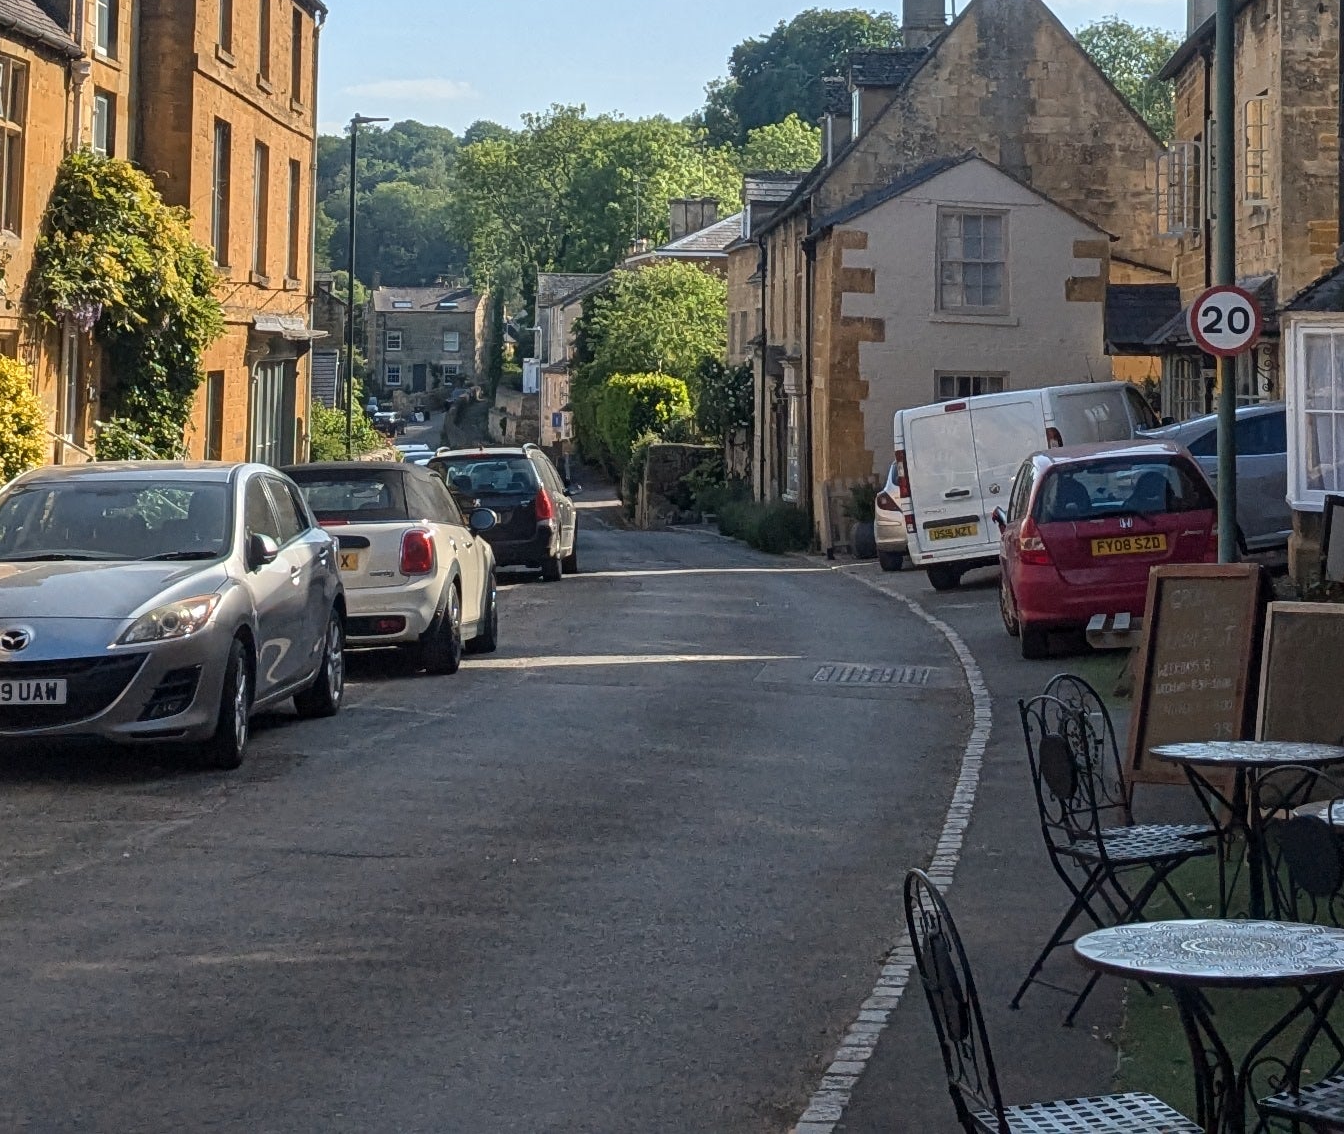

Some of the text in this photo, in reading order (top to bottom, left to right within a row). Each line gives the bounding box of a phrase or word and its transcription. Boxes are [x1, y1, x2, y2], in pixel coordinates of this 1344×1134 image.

[1202, 305, 1250, 335] 20
[1097, 536, 1161, 553] FY08 SZD
[18, 681, 58, 701] UAW
